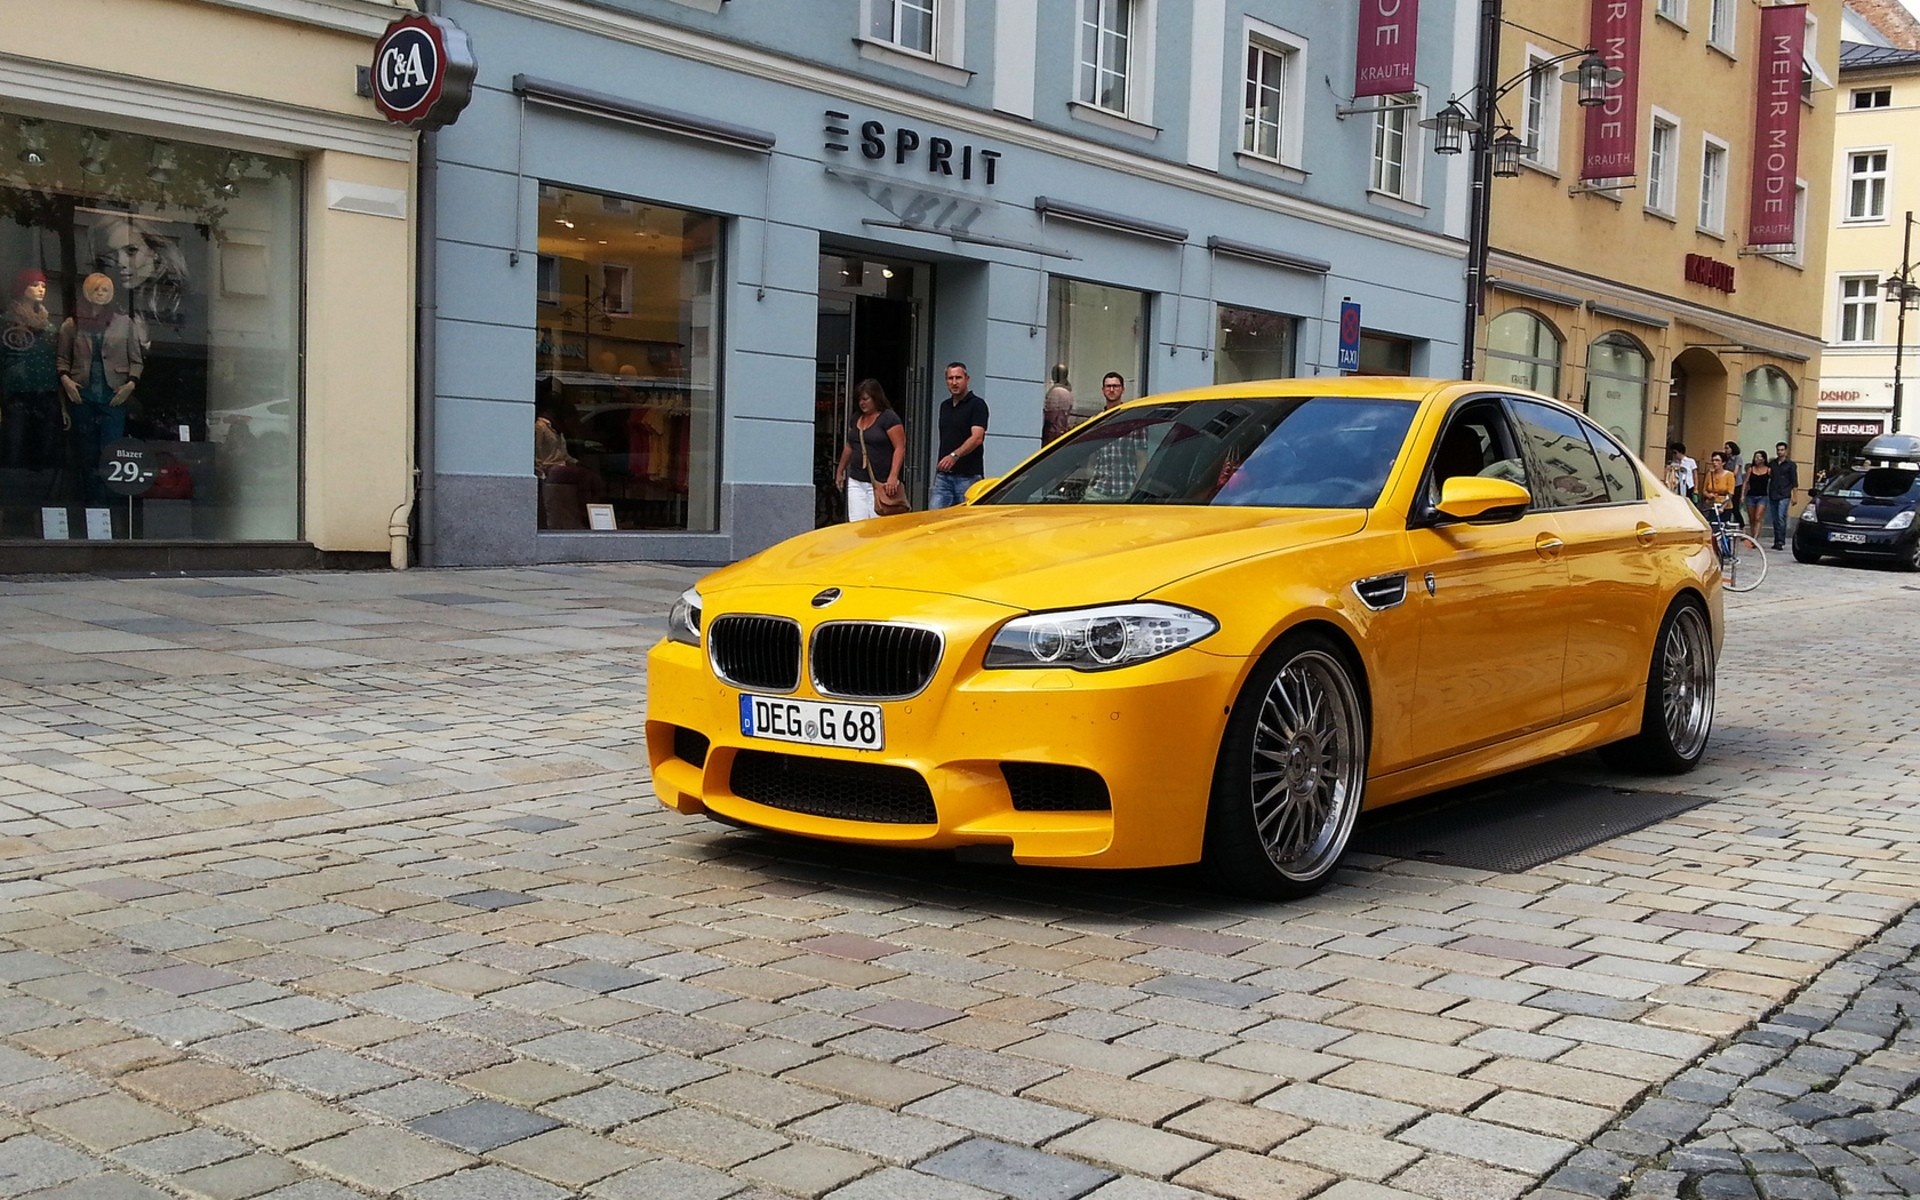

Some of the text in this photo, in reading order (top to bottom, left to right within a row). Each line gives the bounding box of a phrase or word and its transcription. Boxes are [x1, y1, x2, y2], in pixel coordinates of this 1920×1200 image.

[380, 43, 429, 92] C&A
[1765, 35, 1791, 213] MEHR MODE
[824, 109, 1002, 185] ESPRIT
[1340, 348, 1358, 365] TAXI
[1818, 390, 1860, 401] DSHOP
[116, 449, 143, 459] Blazer
[107, 460, 153, 483] 29.-
[744, 718, 751, 728] D
[755, 700, 876, 744] DEG G 68
